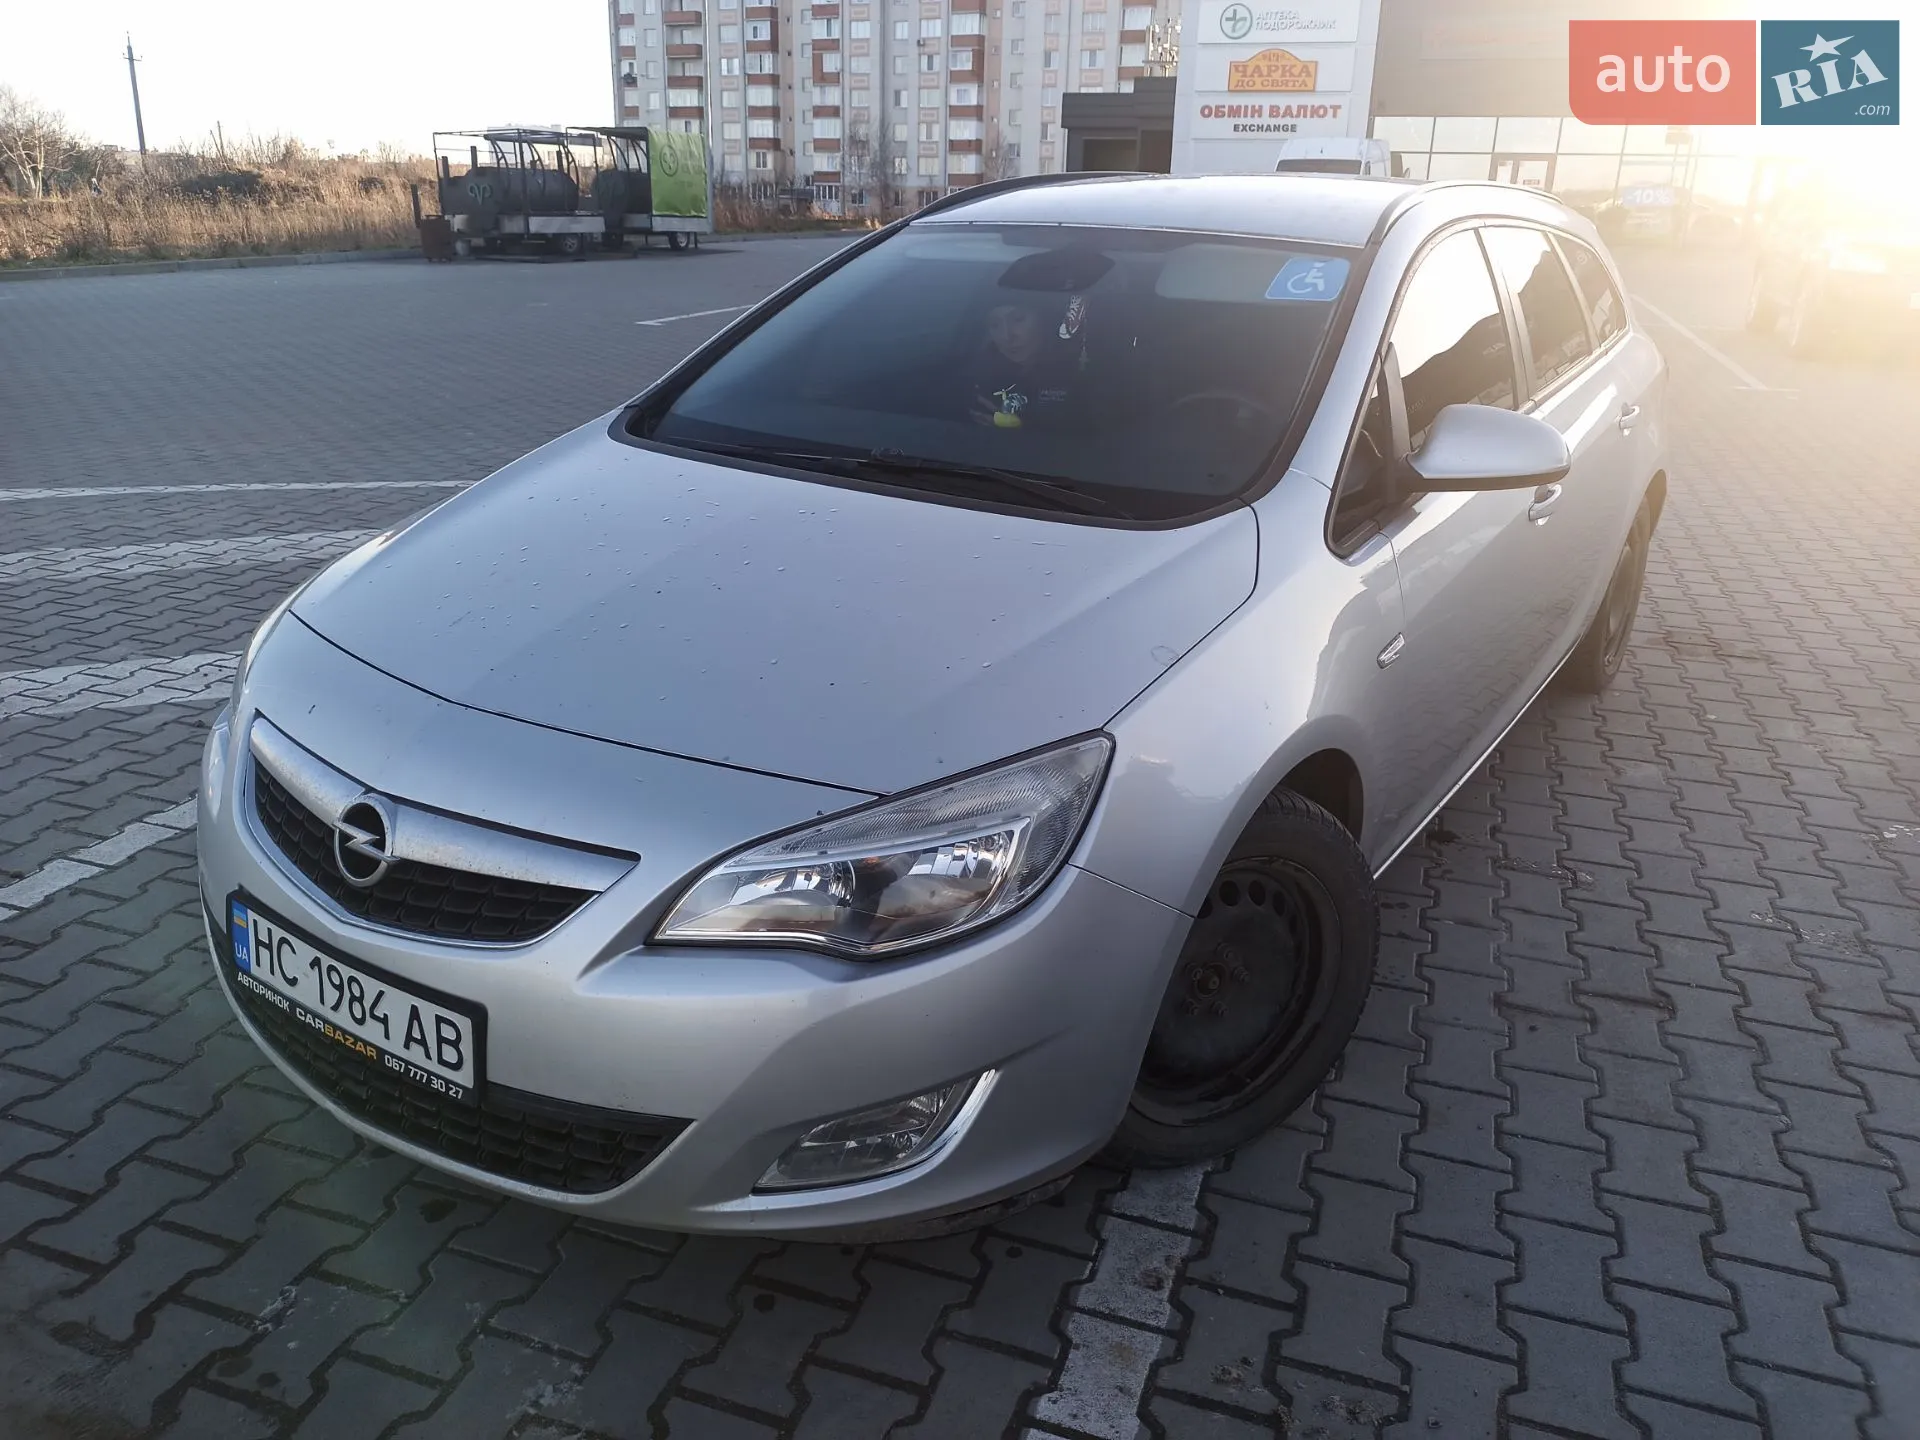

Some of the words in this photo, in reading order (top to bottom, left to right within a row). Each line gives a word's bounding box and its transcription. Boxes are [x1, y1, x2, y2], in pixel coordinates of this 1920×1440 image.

[1256, 10, 1300, 21] АПТЕКА
[1255, 19, 1337, 31] ПОДОРОЖНИК
[1233, 64, 1312, 79] ЧАРКА
[1234, 79, 1256, 89] ДО
[1260, 79, 1309, 89] СВЯТА
[1199, 104, 1264, 120] ОБМІН
[1268, 104, 1342, 120] ВАЛЮТ
[1233, 123, 1298, 134] EXCHANGE
[235, 942, 249, 962] UA
[309, 955, 391, 1041] 1984
[403, 1003, 464, 1072] AB
[237, 971, 290, 1012] АВТОРИНОК
[296, 1007, 377, 1060] CARBAZAR
[384, 1055, 405, 1073] 067
[408, 1064, 428, 1082] 777
[430, 1075, 446, 1093] 30
[448, 1085, 463, 1100] 27
